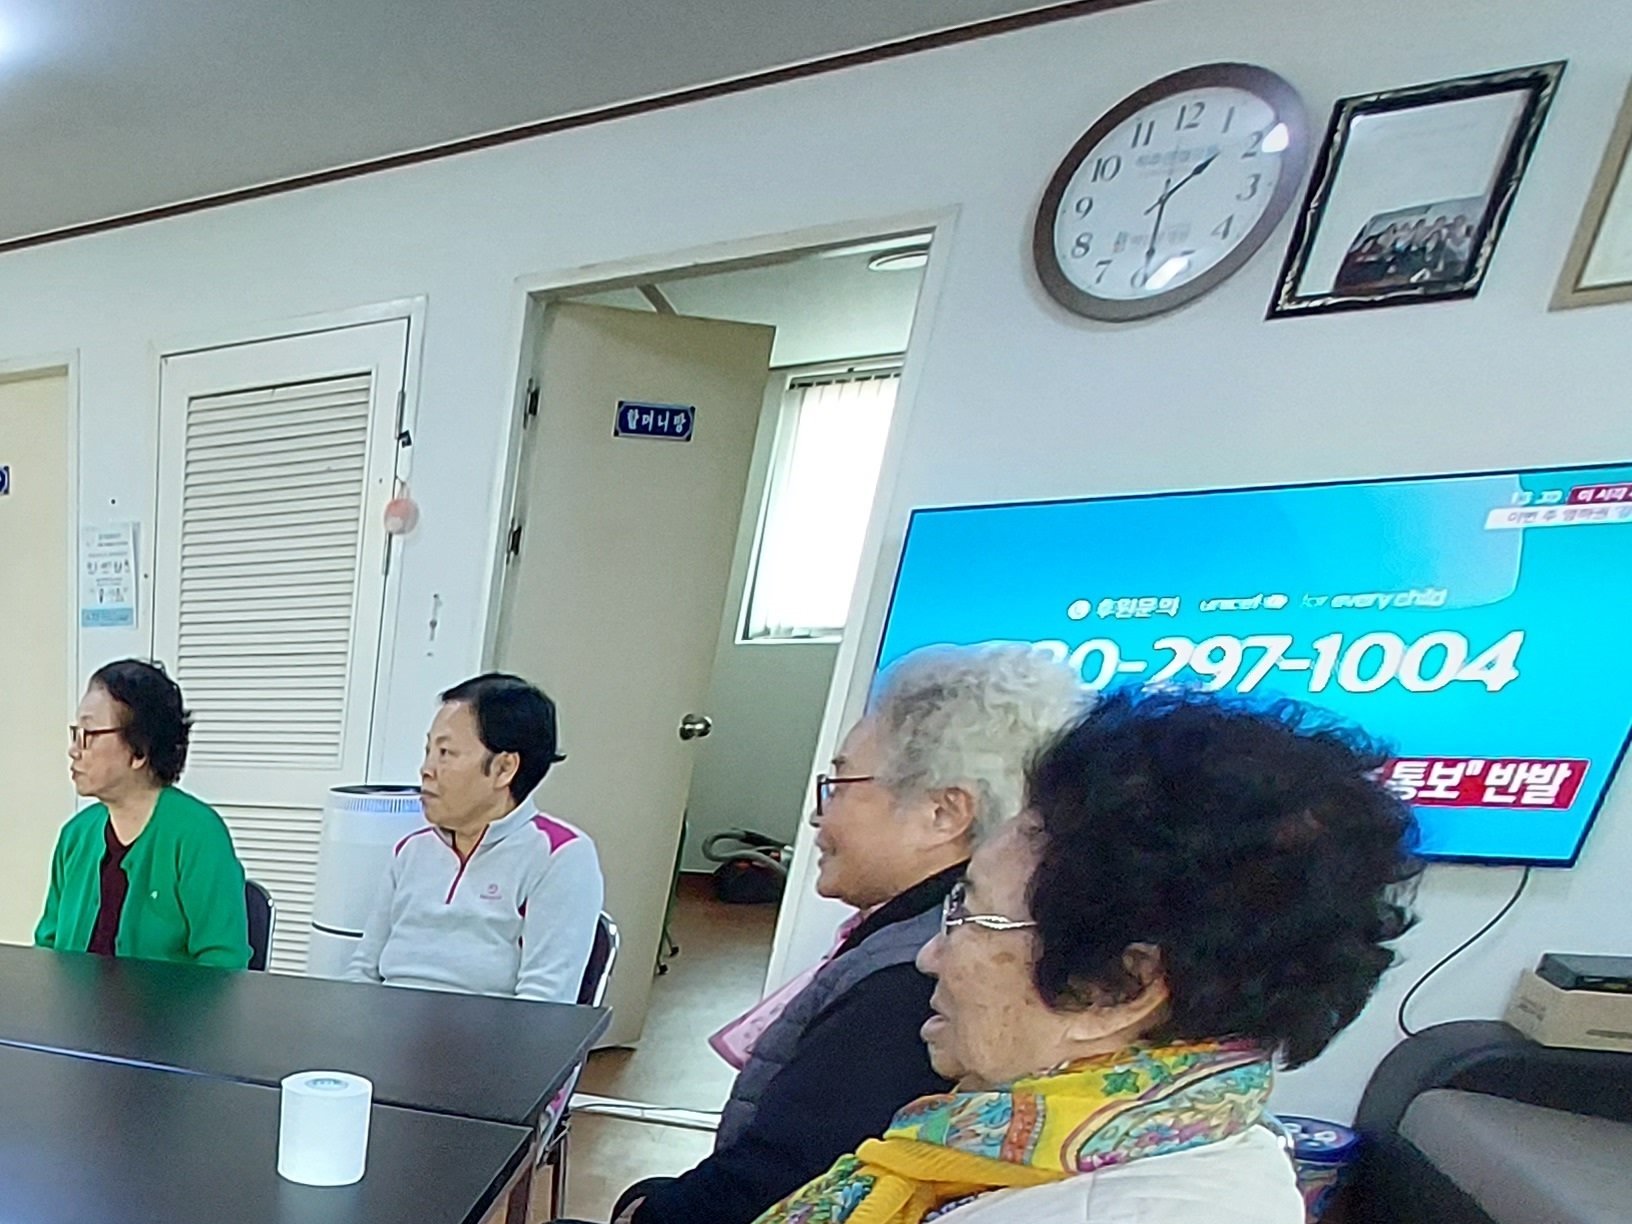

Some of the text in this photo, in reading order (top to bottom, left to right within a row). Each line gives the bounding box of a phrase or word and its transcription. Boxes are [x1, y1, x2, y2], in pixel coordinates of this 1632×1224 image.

[1175, 101, 1205, 131] 12
[1221, 106, 1235, 134] 1
[1131, 119, 1156, 149] 11
[1241, 130, 1264, 159] 2
[1091, 154, 1122, 183] 10
[1235, 173, 1261, 202] 3
[1075, 195, 1094, 221] 9
[1211, 213, 1235, 241] 4
[1071, 232, 1094, 259] 8
[1094, 259, 1114, 285] 7
[627, 408, 686, 433] 할머니방
[1578, 489, 1595, 502] 이
[1330, 593, 1393, 610] every
[1393, 587, 1448, 608] child
[1482, 762, 1572, 805] 반발
